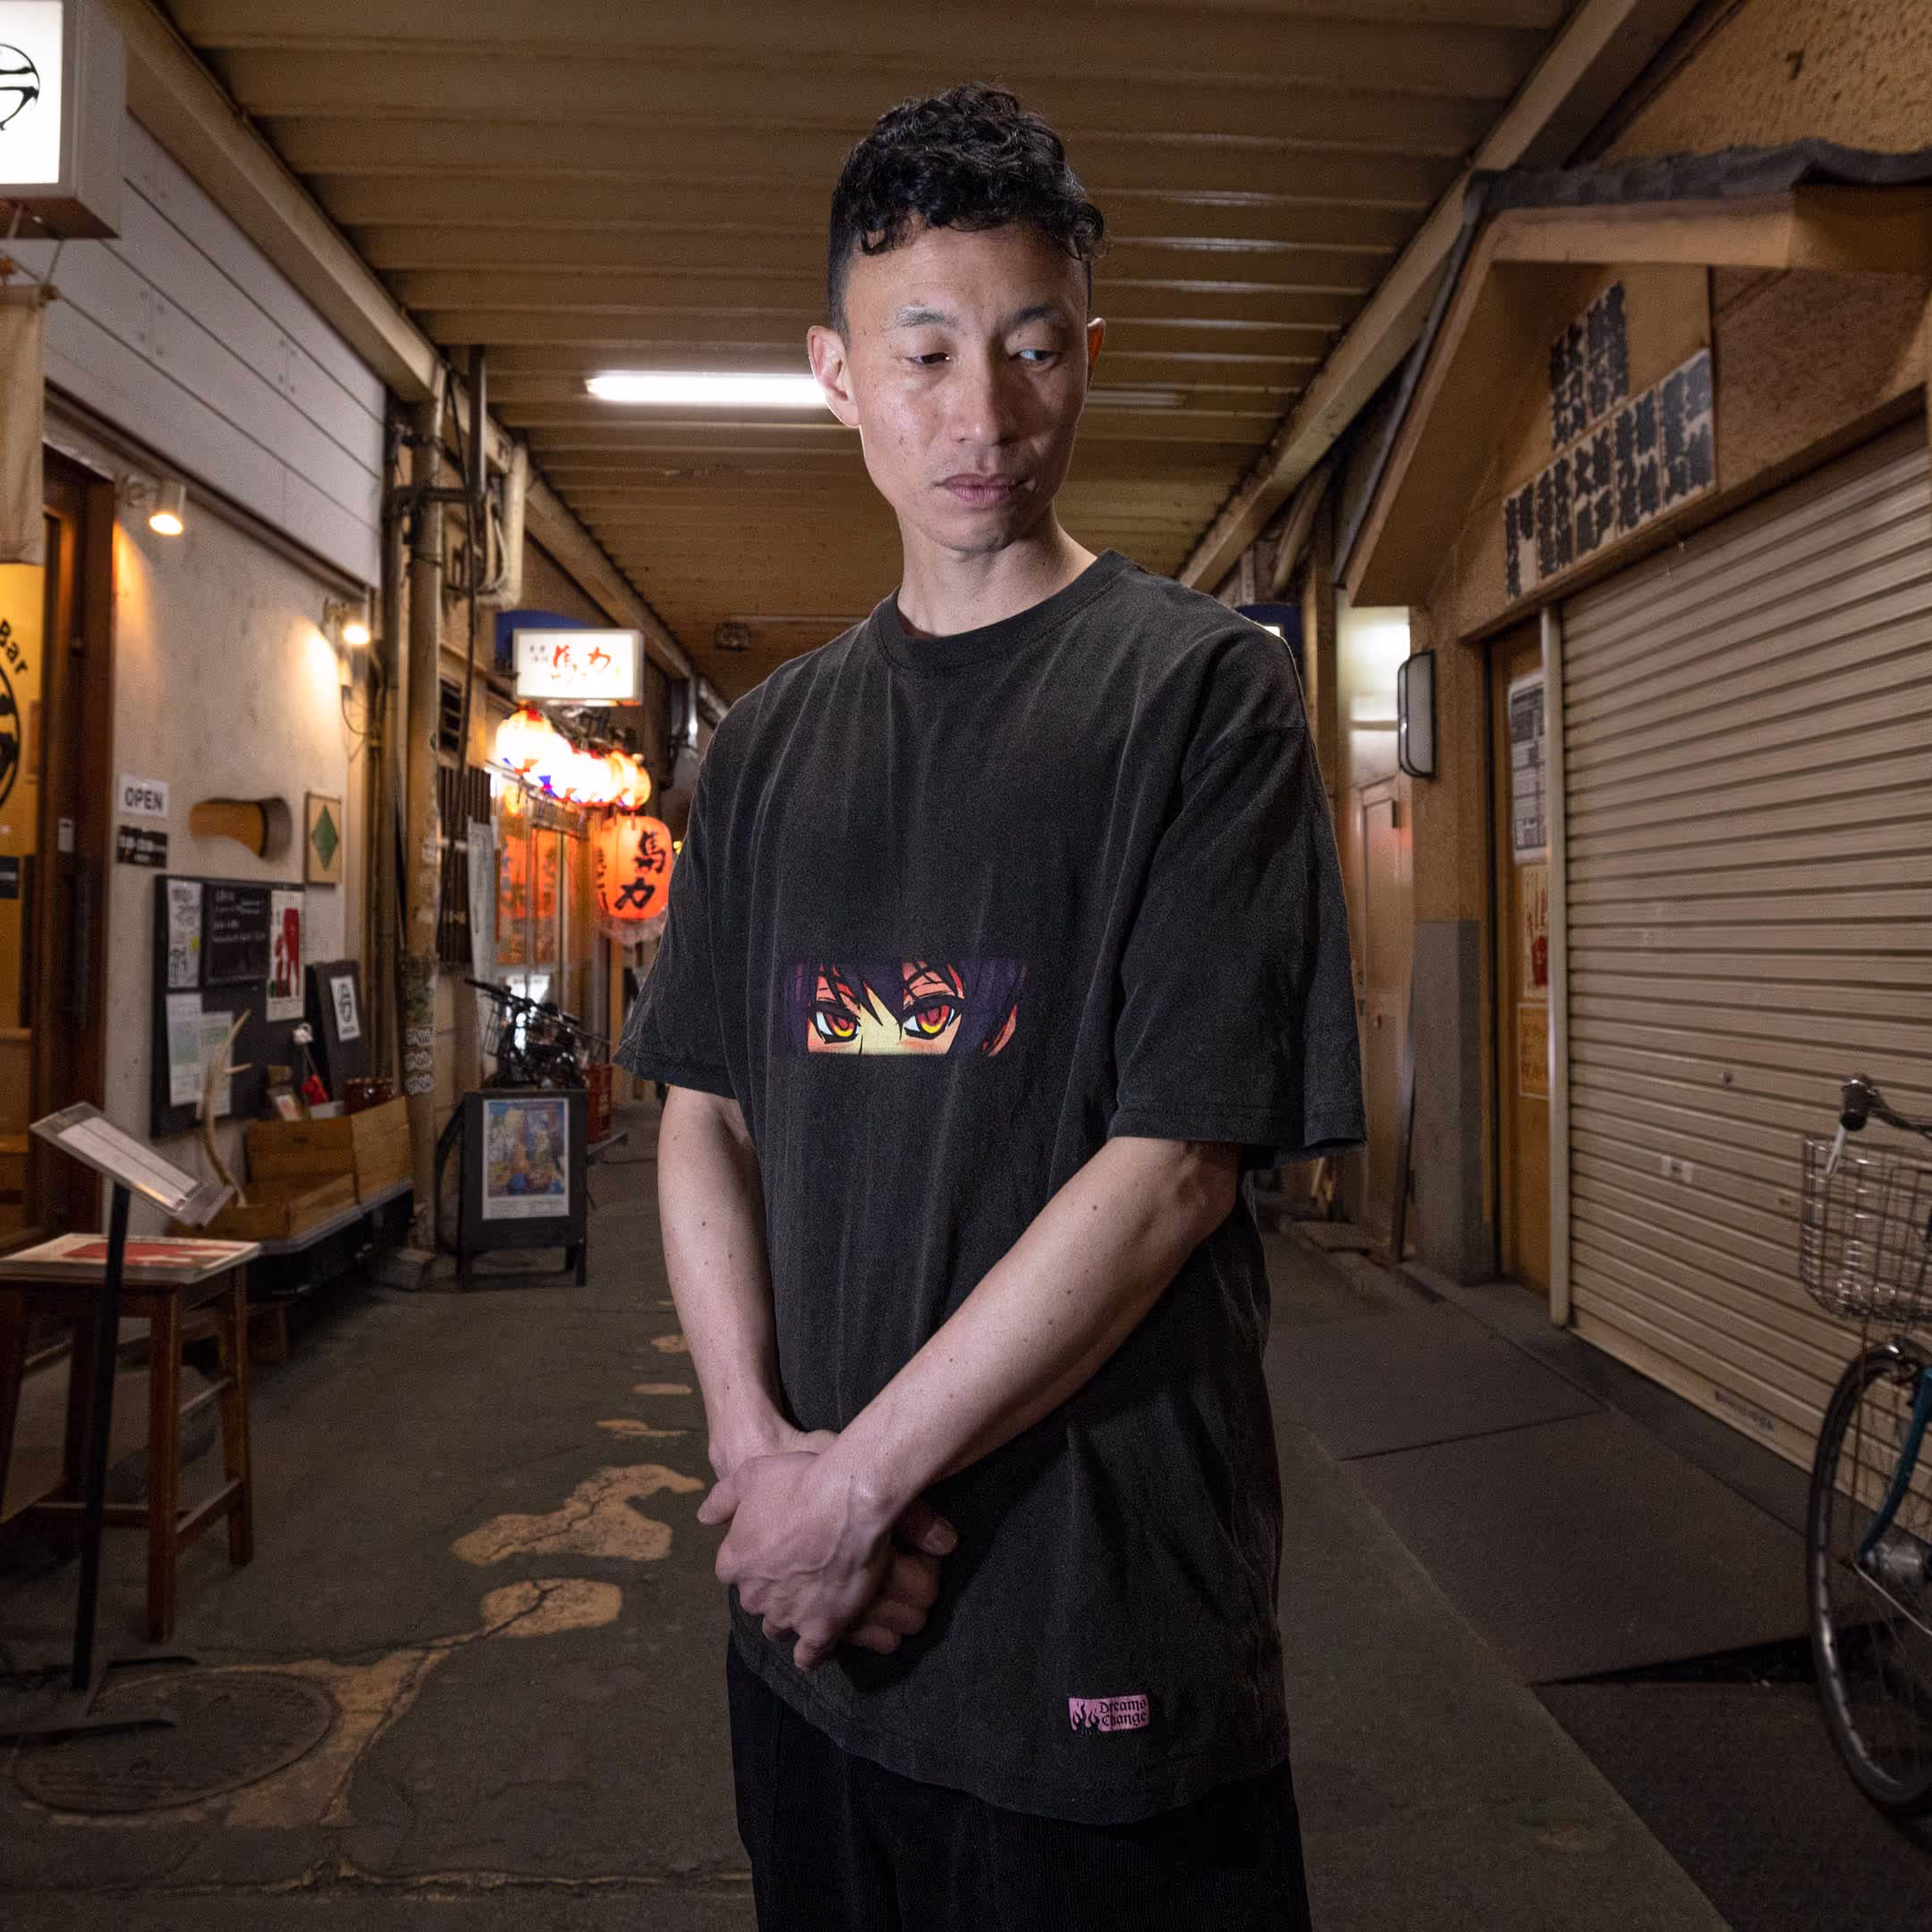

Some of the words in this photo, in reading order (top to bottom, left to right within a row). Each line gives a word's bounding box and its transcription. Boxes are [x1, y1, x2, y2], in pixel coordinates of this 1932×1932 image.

[124, 786, 164, 811] OPEN
[614, 830, 666, 911] 馬力
[1098, 1699, 1147, 1714] Dreams
[1101, 1712, 1147, 1727] Change
